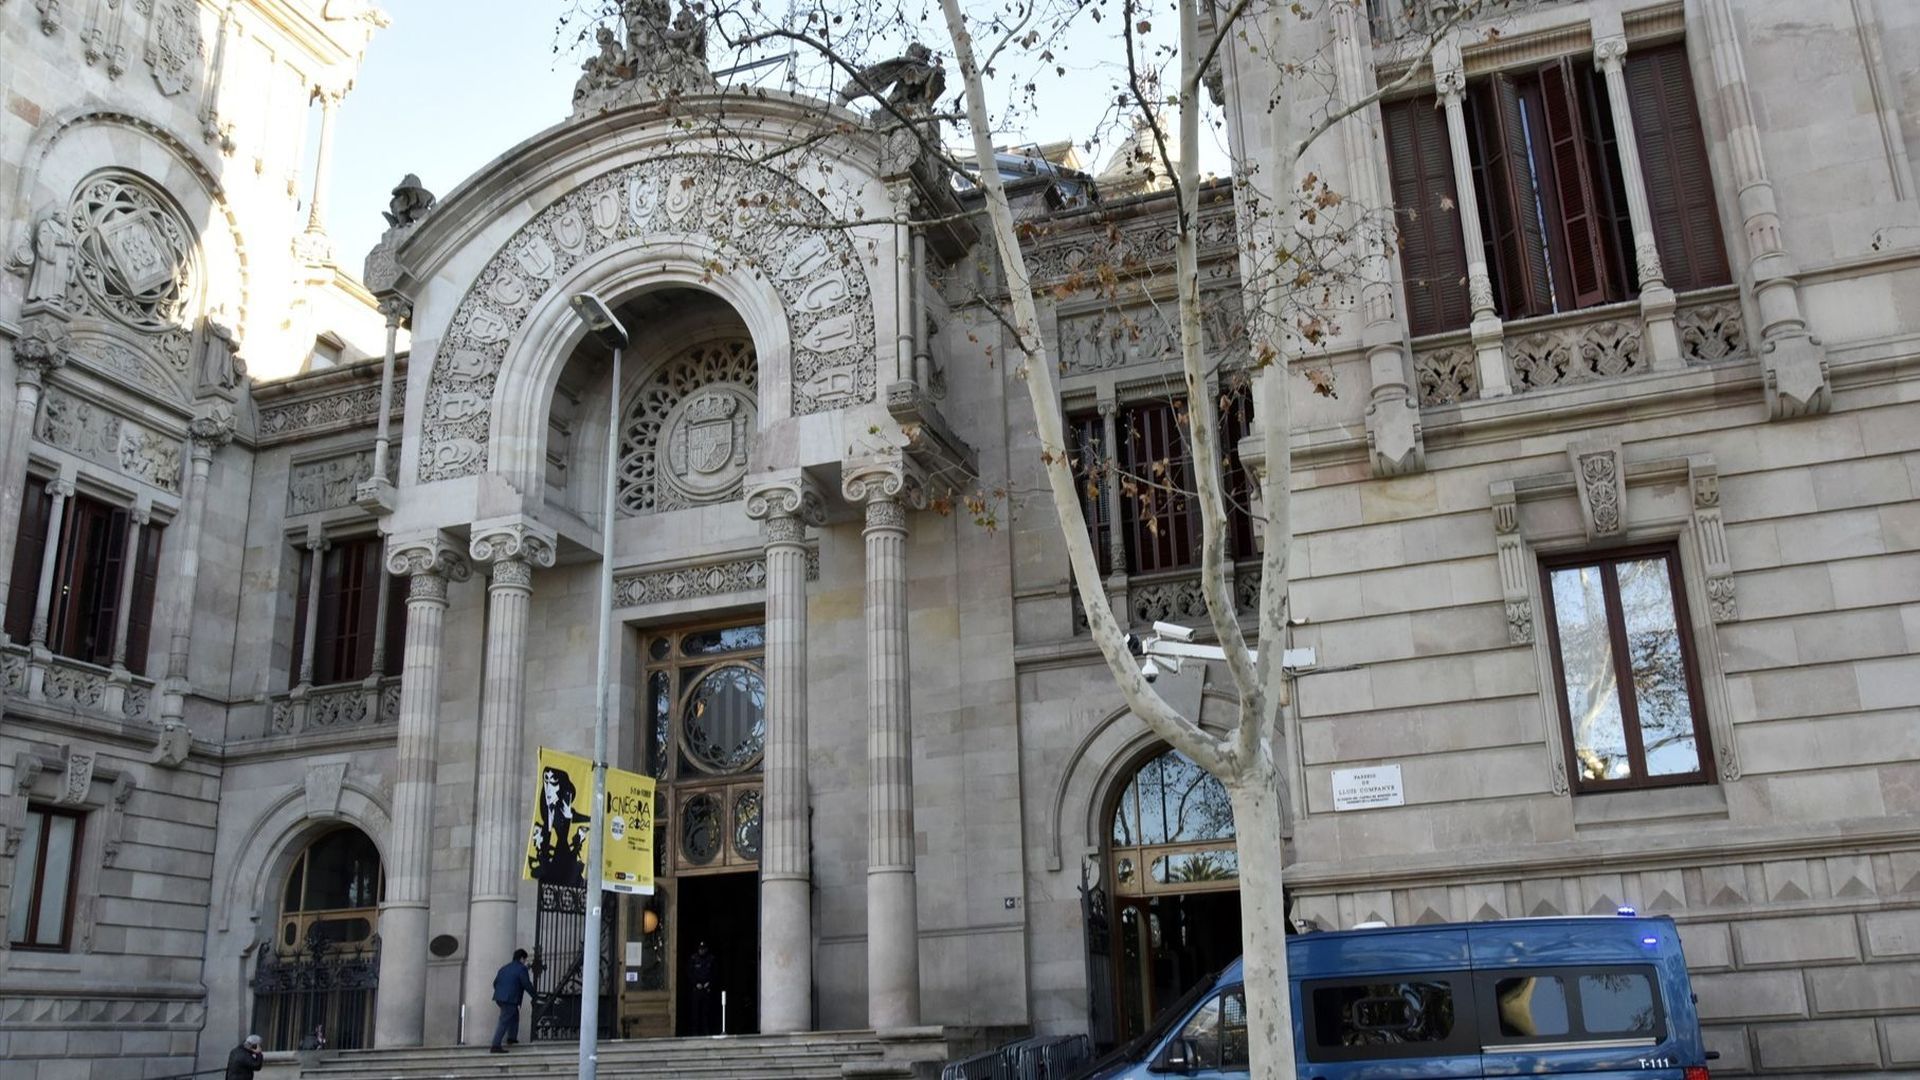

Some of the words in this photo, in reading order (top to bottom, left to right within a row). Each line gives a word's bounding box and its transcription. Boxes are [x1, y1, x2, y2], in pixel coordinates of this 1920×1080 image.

[438, 215, 583, 468] PALACIO
[593, 177, 656, 232] DE
[1639, 1057, 1669, 1069] T-111
